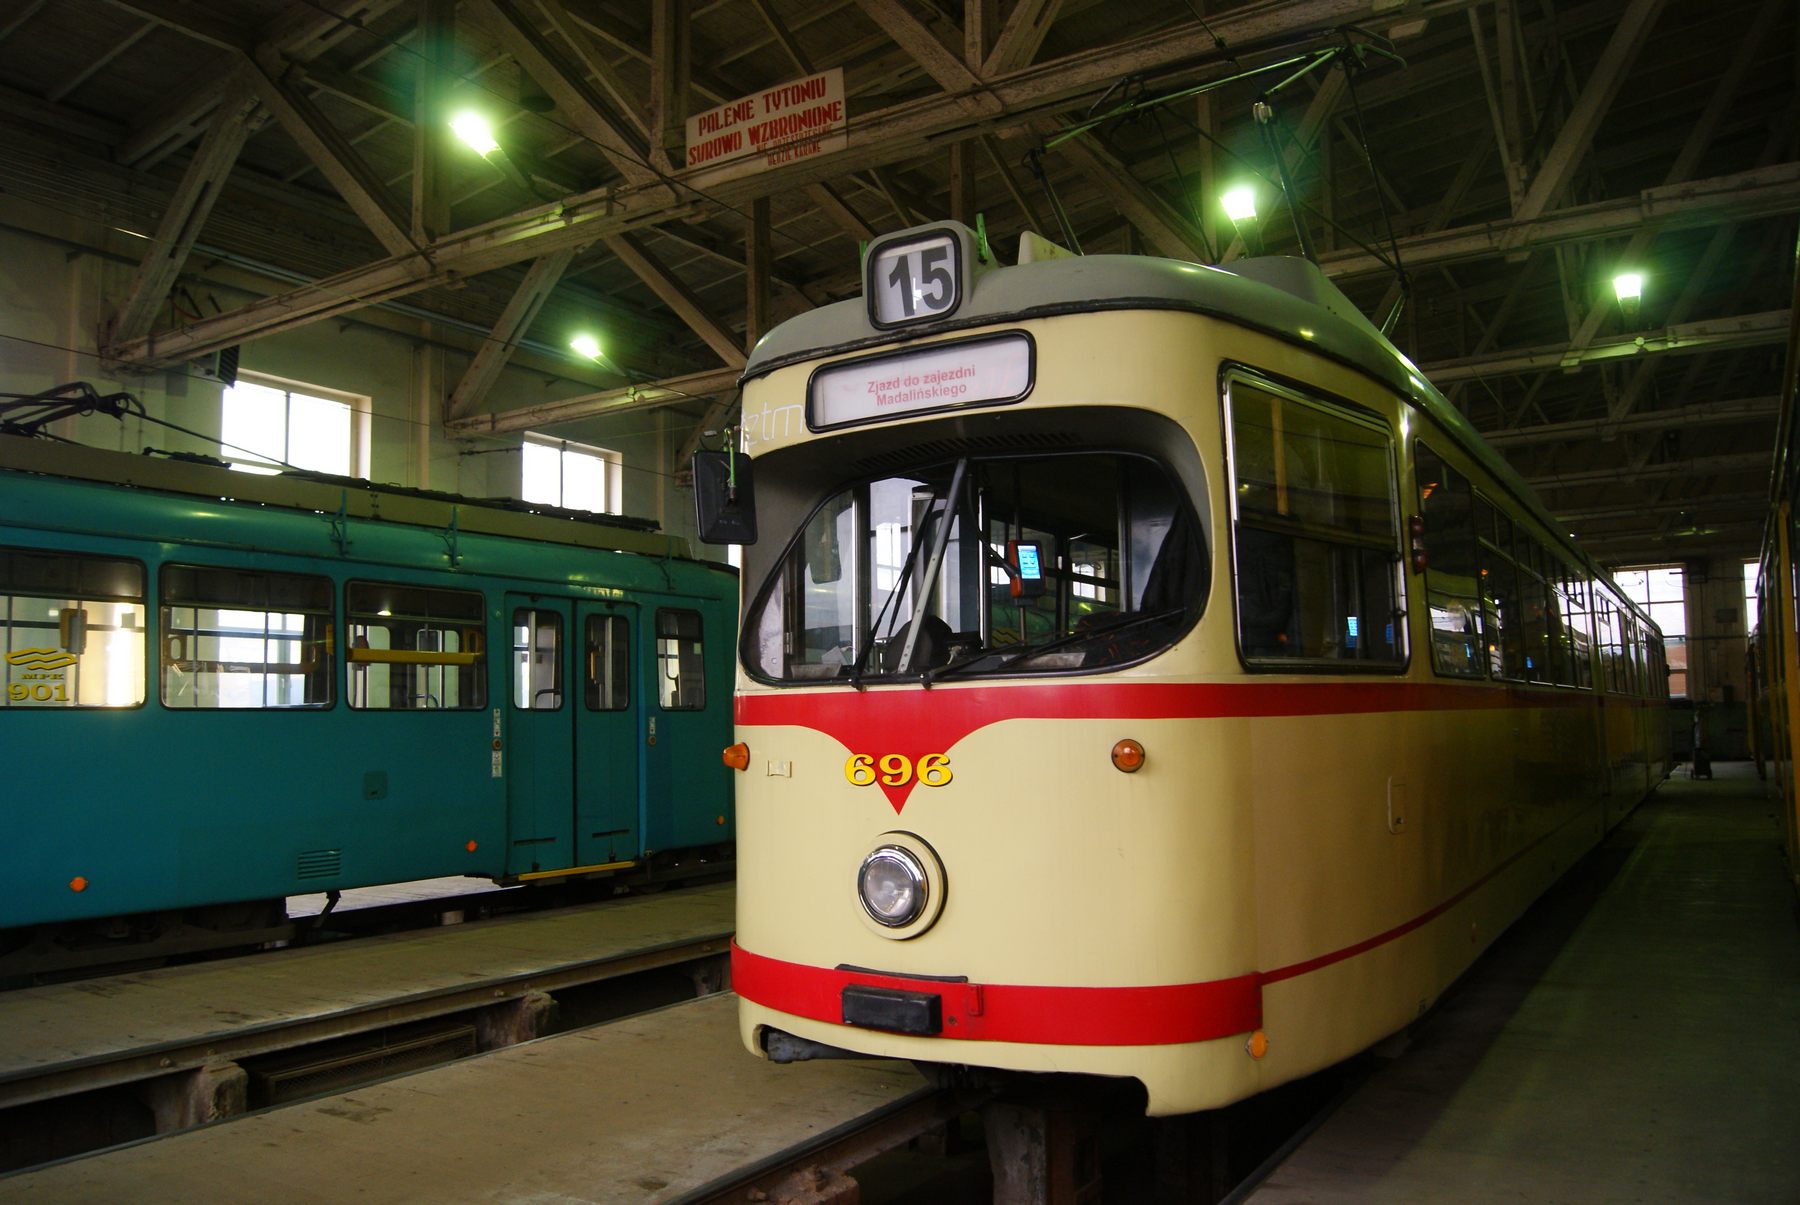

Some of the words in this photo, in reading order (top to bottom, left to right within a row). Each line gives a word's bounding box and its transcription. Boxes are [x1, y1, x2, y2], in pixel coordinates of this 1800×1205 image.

[699, 99, 755, 136] PALENIE
[763, 76, 826, 114] TYTONIU
[688, 131, 743, 166] SUROWO
[748, 101, 843, 146] WZBRONIONE
[889, 246, 953, 317] 15
[867, 375, 902, 395] Zjazd
[903, 372, 921, 387] do
[923, 364, 976, 388] zajezdni
[876, 383, 967, 407] Madalińskiego
[7, 683, 70, 702] 901
[844, 752, 953, 787] 696
